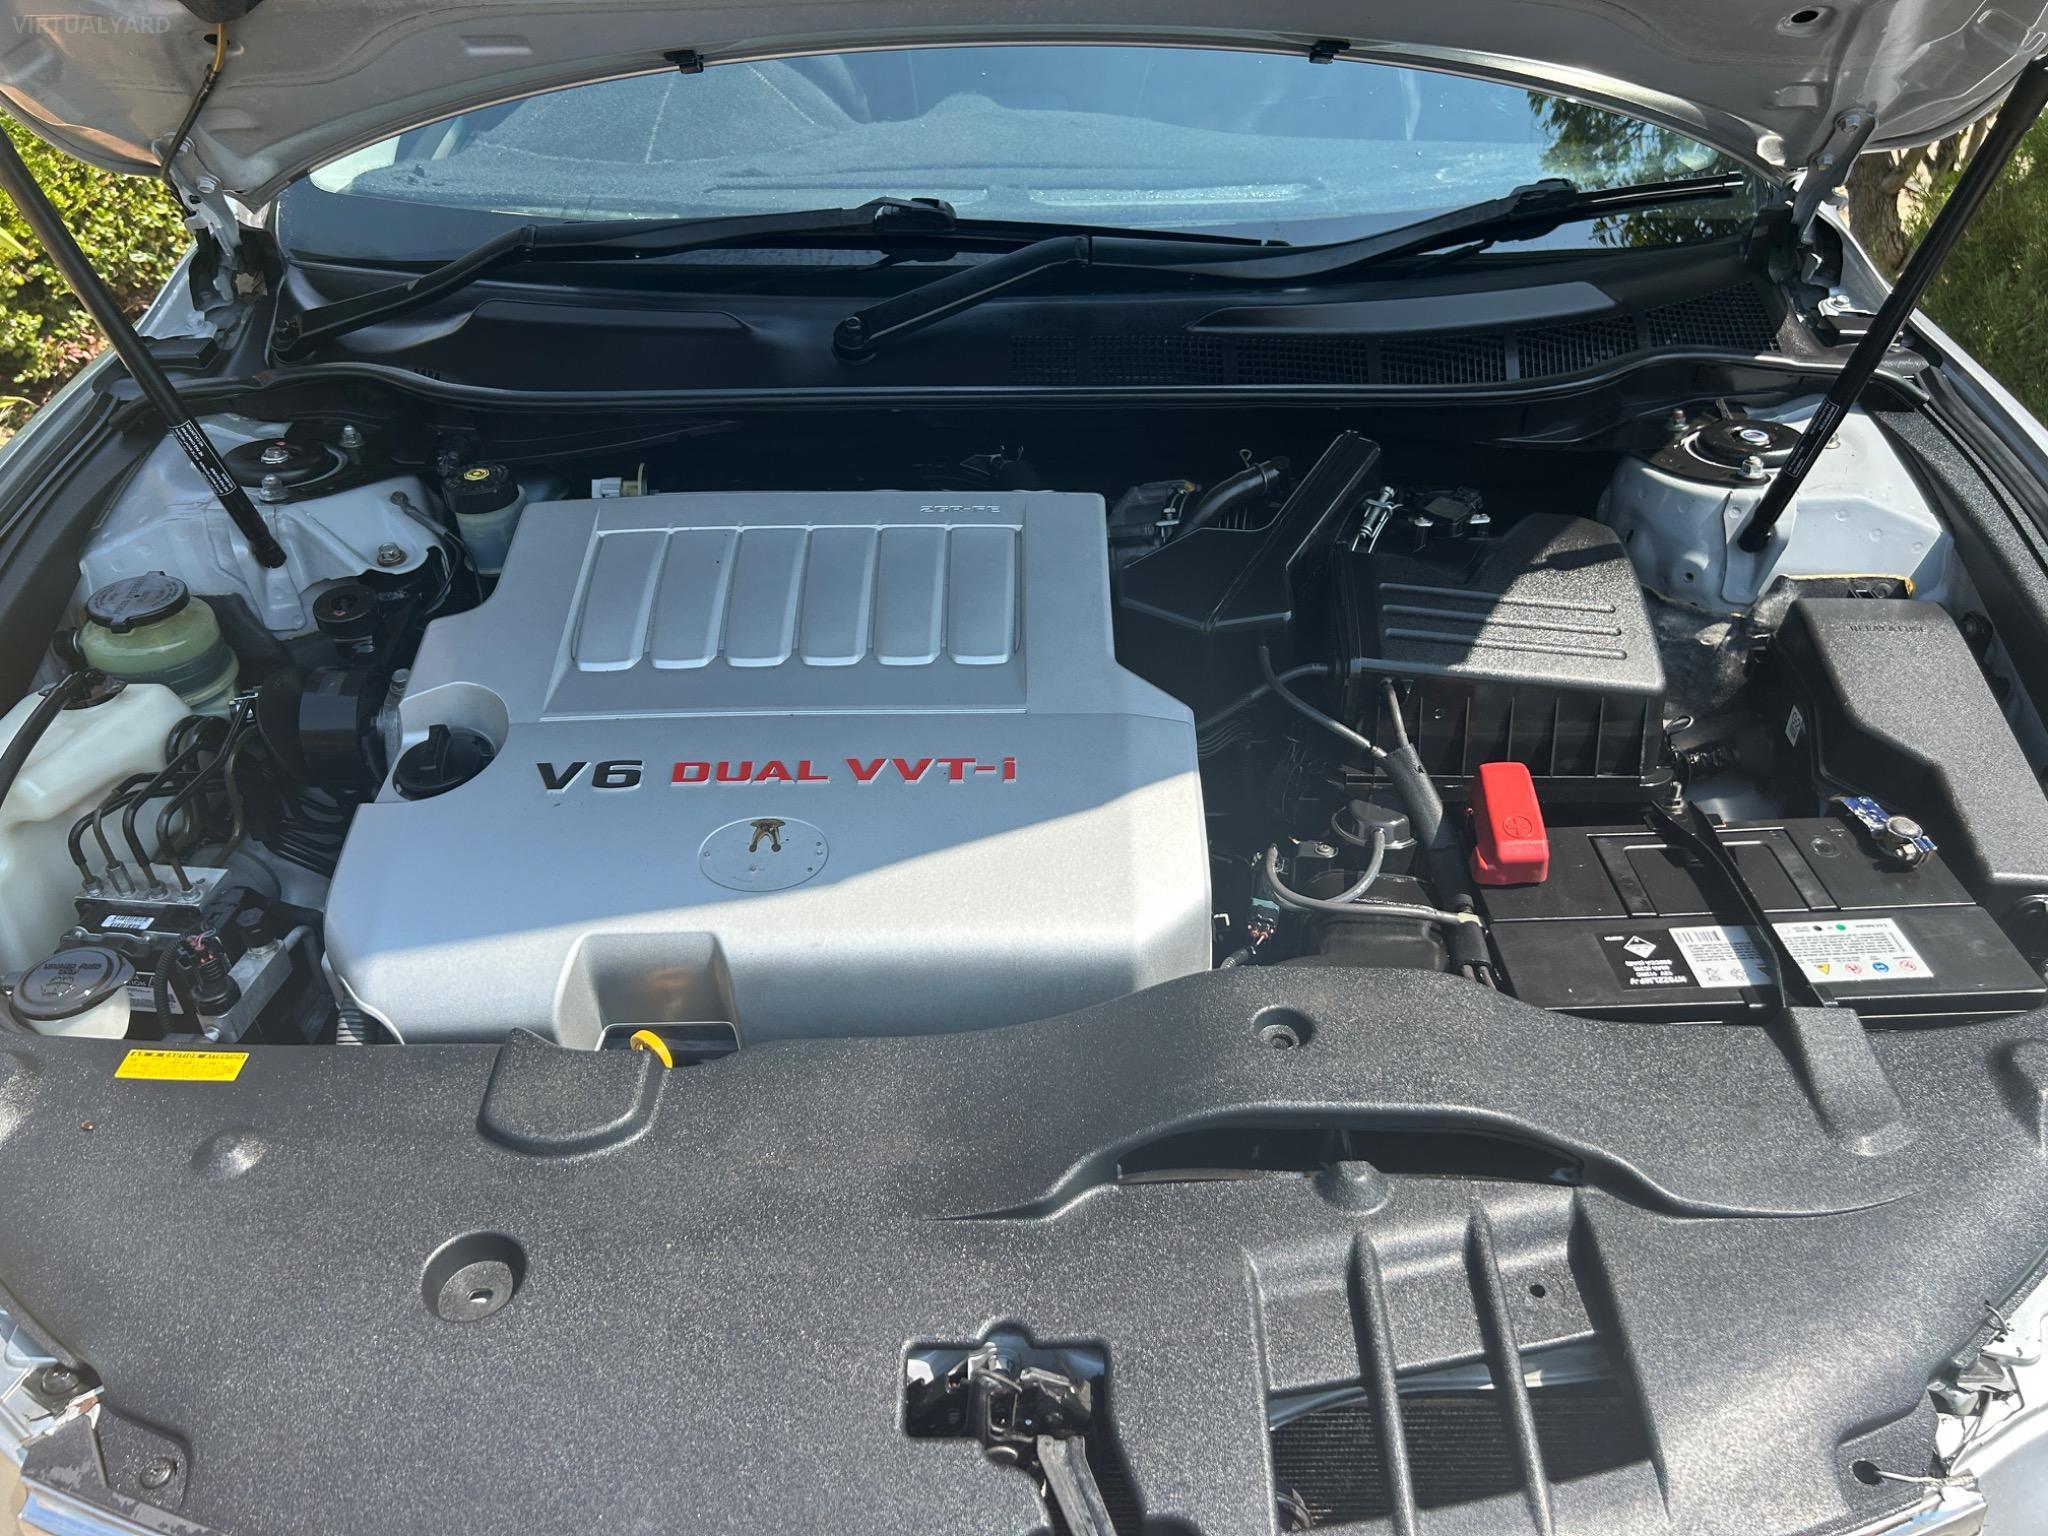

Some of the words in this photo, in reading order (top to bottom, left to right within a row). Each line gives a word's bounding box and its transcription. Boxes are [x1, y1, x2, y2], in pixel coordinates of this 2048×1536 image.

[535, 760, 645, 793] V6
[670, 760, 830, 786] DUAL
[845, 757, 1017, 784] VVT-i
